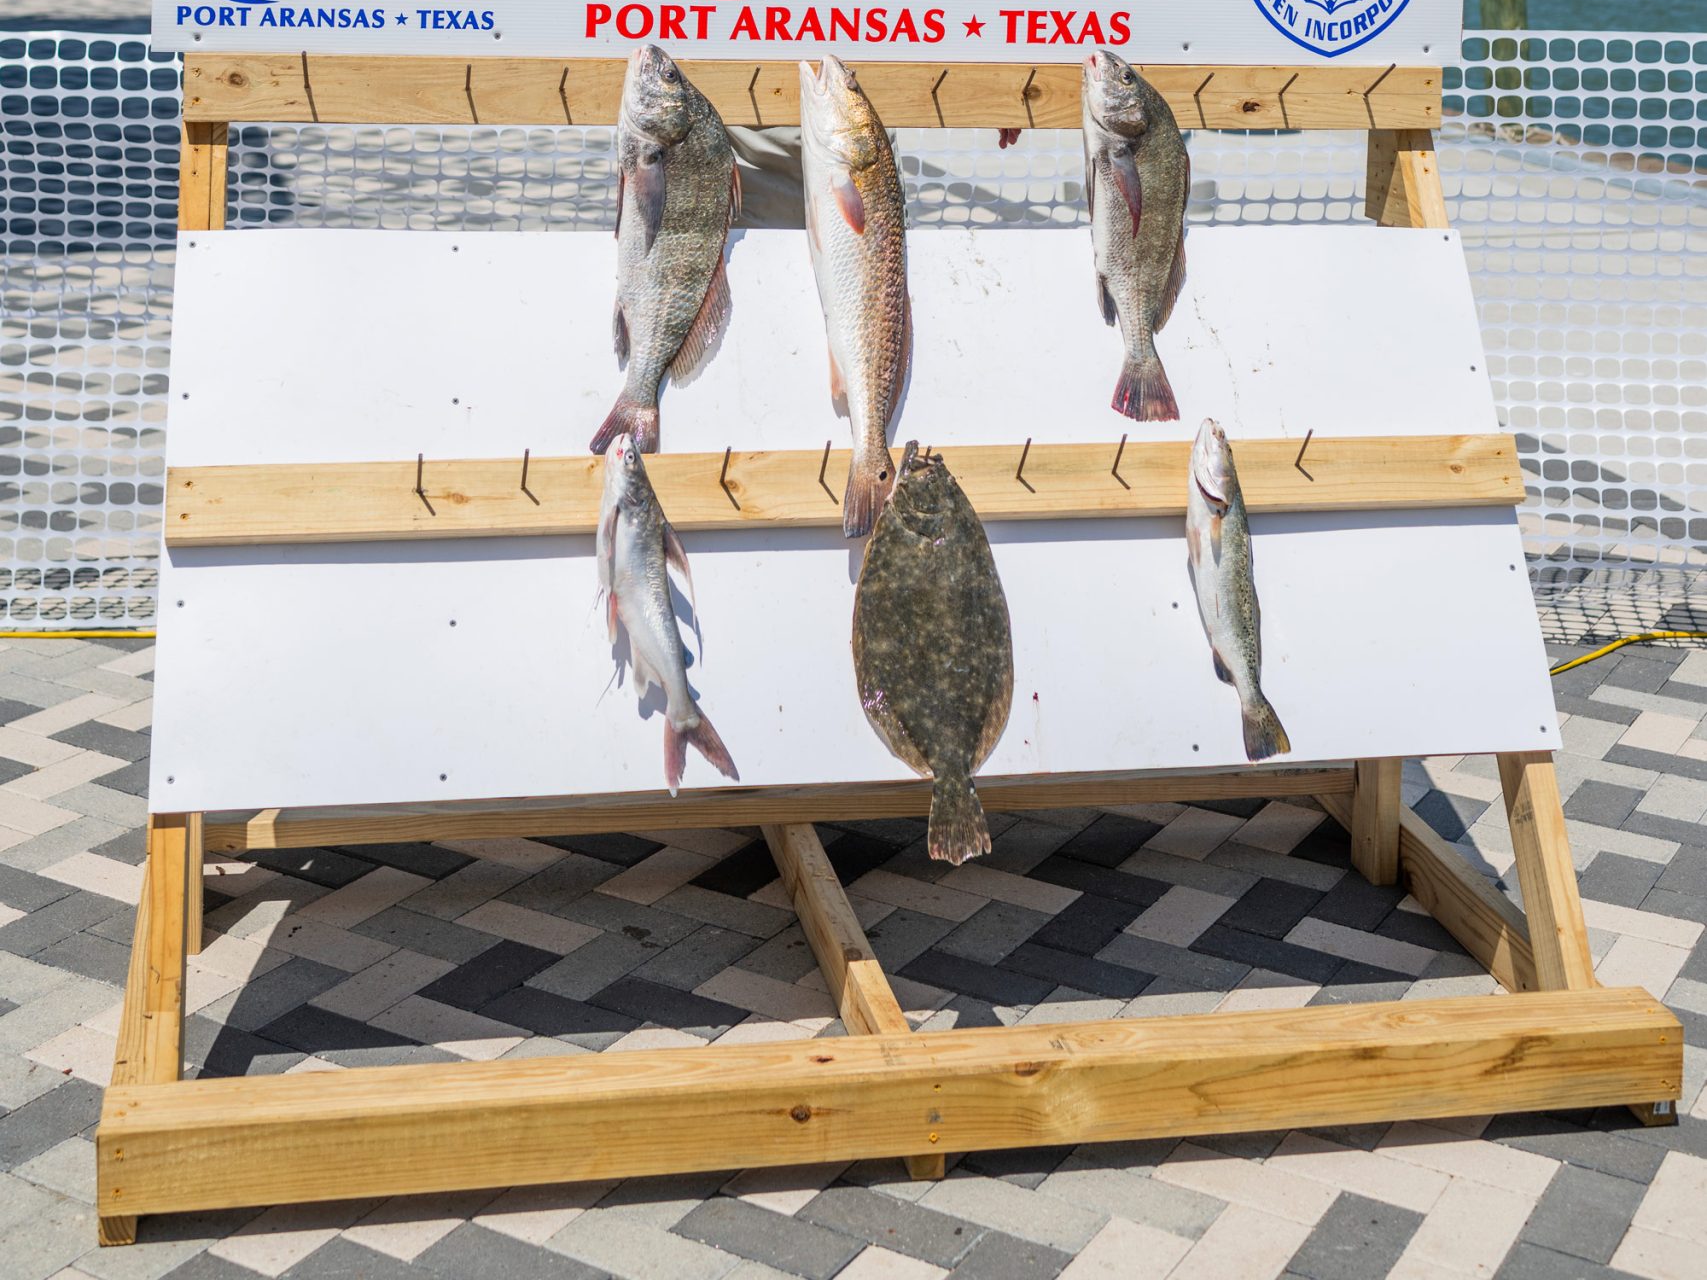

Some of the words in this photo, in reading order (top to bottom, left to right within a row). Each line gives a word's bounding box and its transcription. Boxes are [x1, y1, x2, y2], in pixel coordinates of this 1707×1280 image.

[176, 5, 253, 28] PORT
[259, 6, 386, 30] ARANSAS
[416, 9, 495, 32] TEXAS
[585, 4, 717, 41] PORT
[729, 6, 945, 44] ARANSAS
[999, 10, 1131, 46] TEXAS
